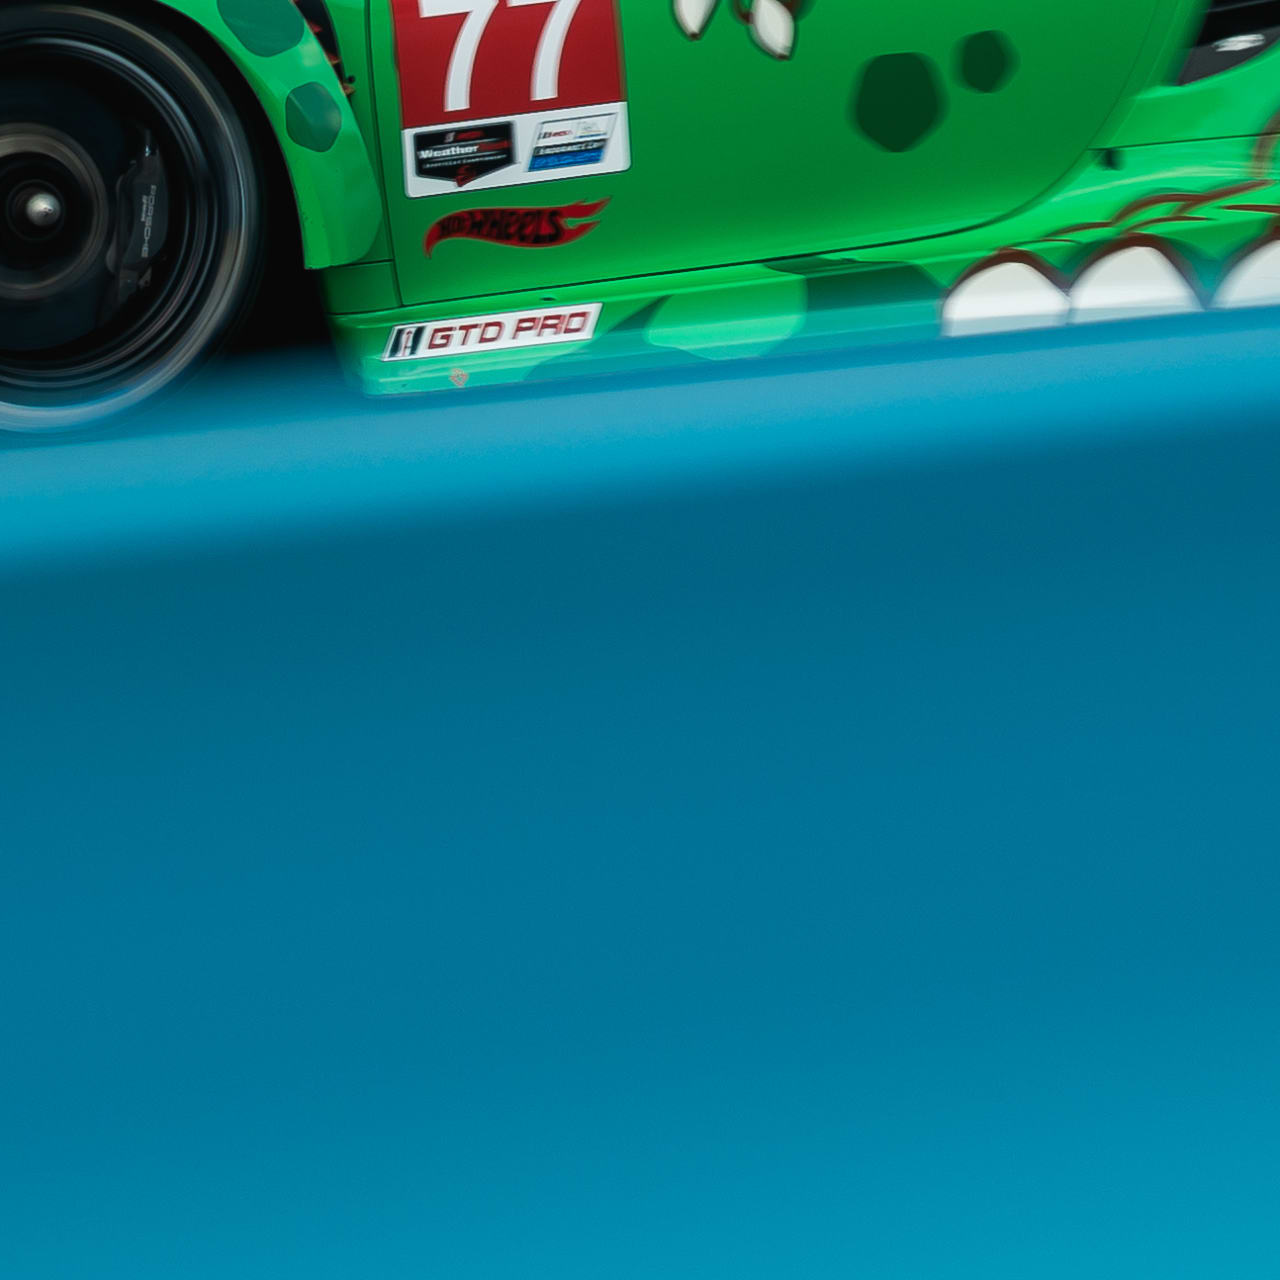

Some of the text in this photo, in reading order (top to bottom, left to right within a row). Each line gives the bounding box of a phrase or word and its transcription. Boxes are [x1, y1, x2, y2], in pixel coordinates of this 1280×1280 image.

[468, 209, 563, 244] WHEELS
[427, 311, 591, 350] GTD PRO
